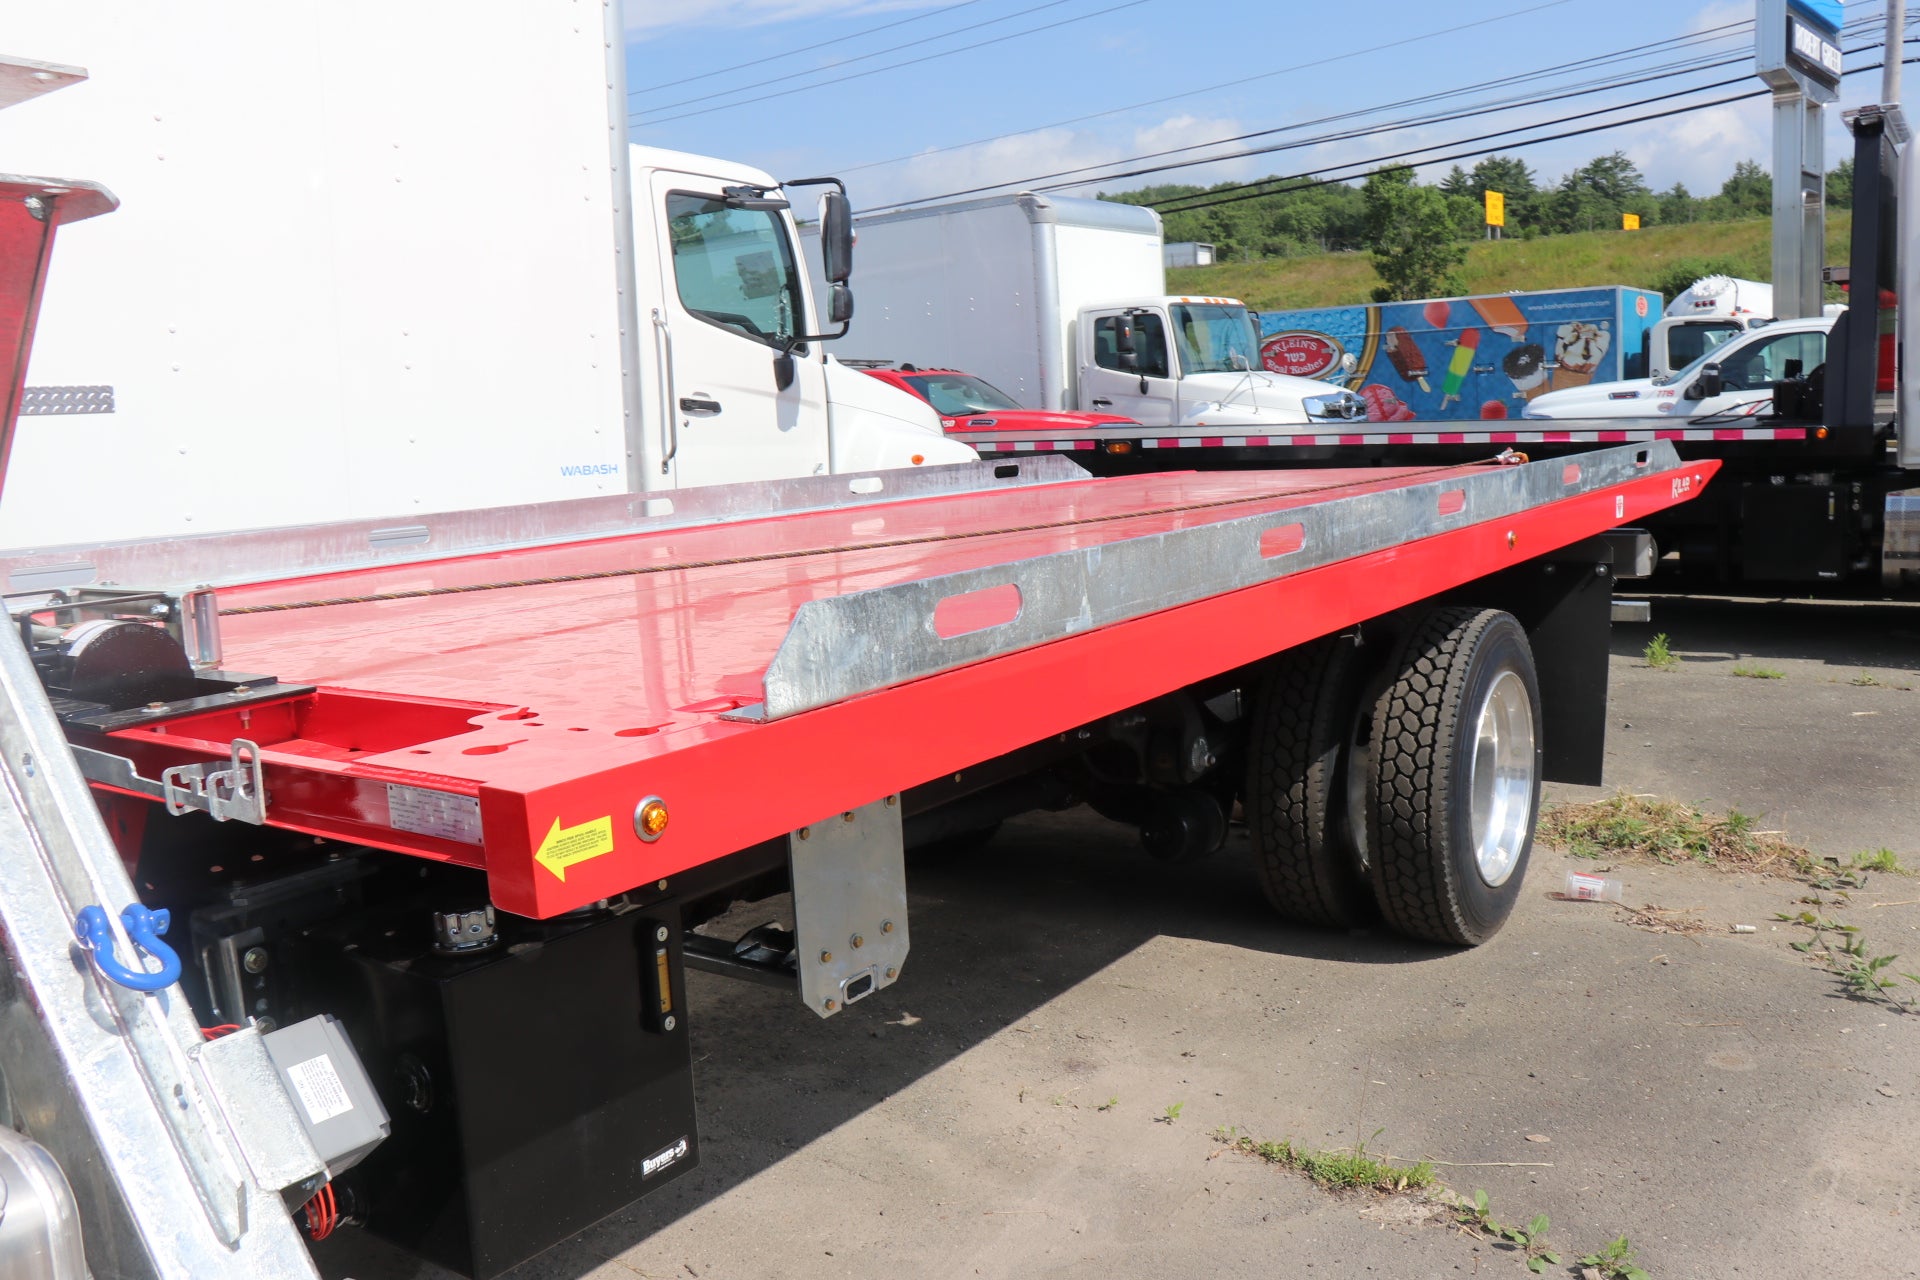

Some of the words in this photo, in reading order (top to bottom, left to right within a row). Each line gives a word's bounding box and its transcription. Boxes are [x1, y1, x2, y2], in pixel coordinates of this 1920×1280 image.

[1272, 339, 1318, 353] KLEIN'S
[1289, 358, 1324, 374] Kosher
[560, 464, 618, 477] WABASH
[643, 1148, 675, 1171] Buyers
